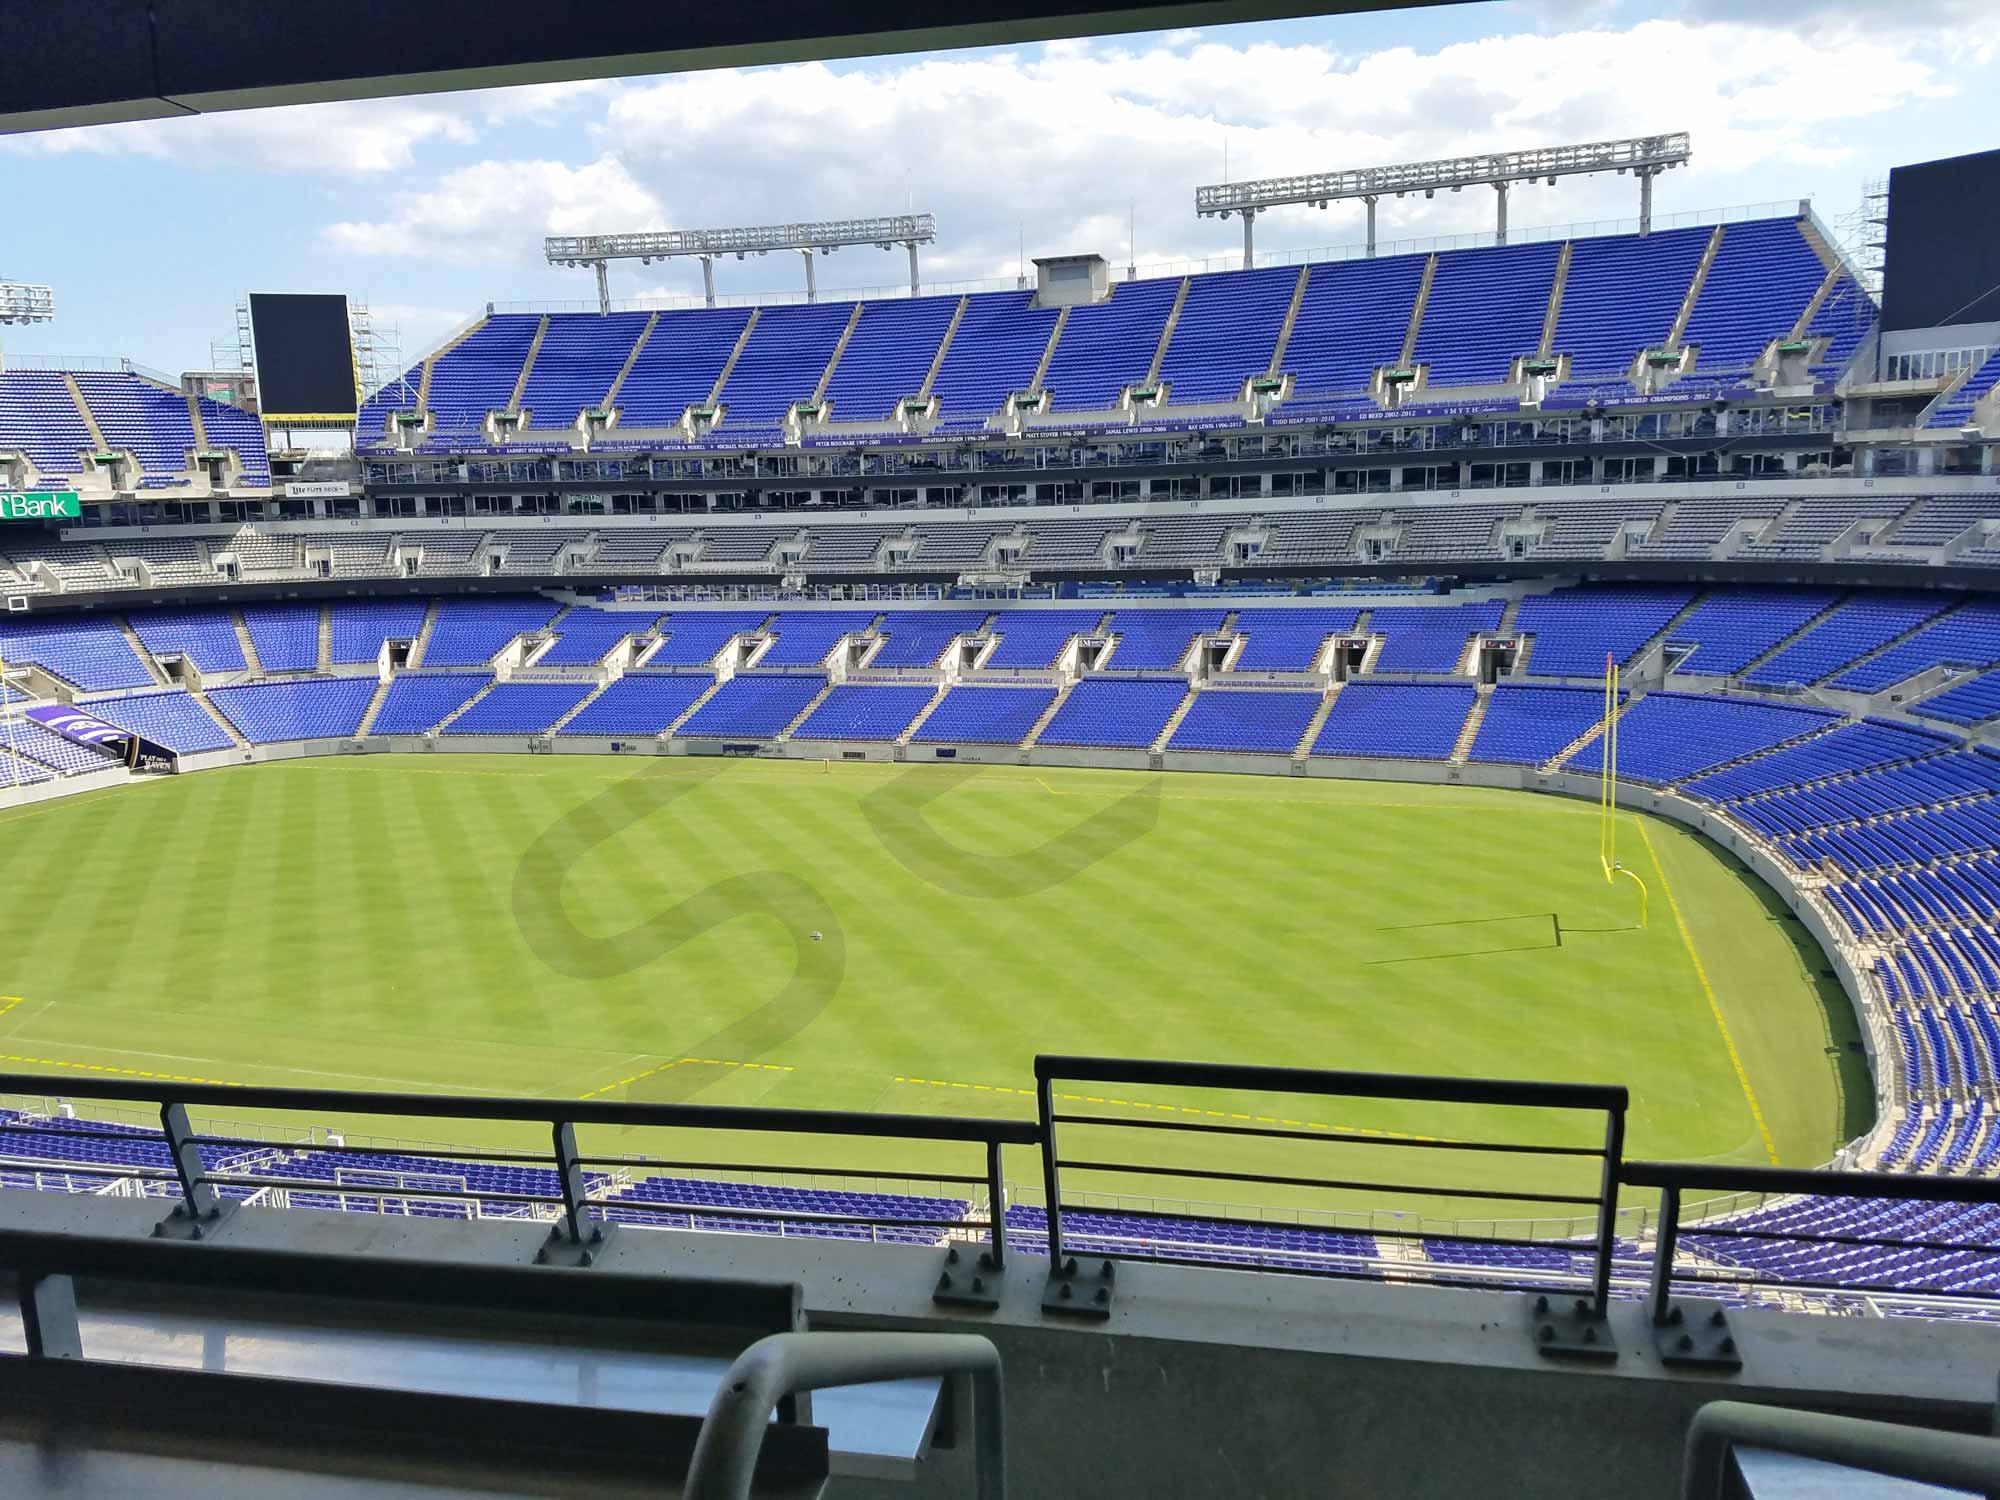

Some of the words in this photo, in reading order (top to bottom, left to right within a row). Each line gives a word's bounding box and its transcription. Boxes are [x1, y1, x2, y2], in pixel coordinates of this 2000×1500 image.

[1649, 395, 1690, 403] CHAMPIONS
[11, 494, 68, 517] Bank
[144, 761, 171, 770] RAVEN
